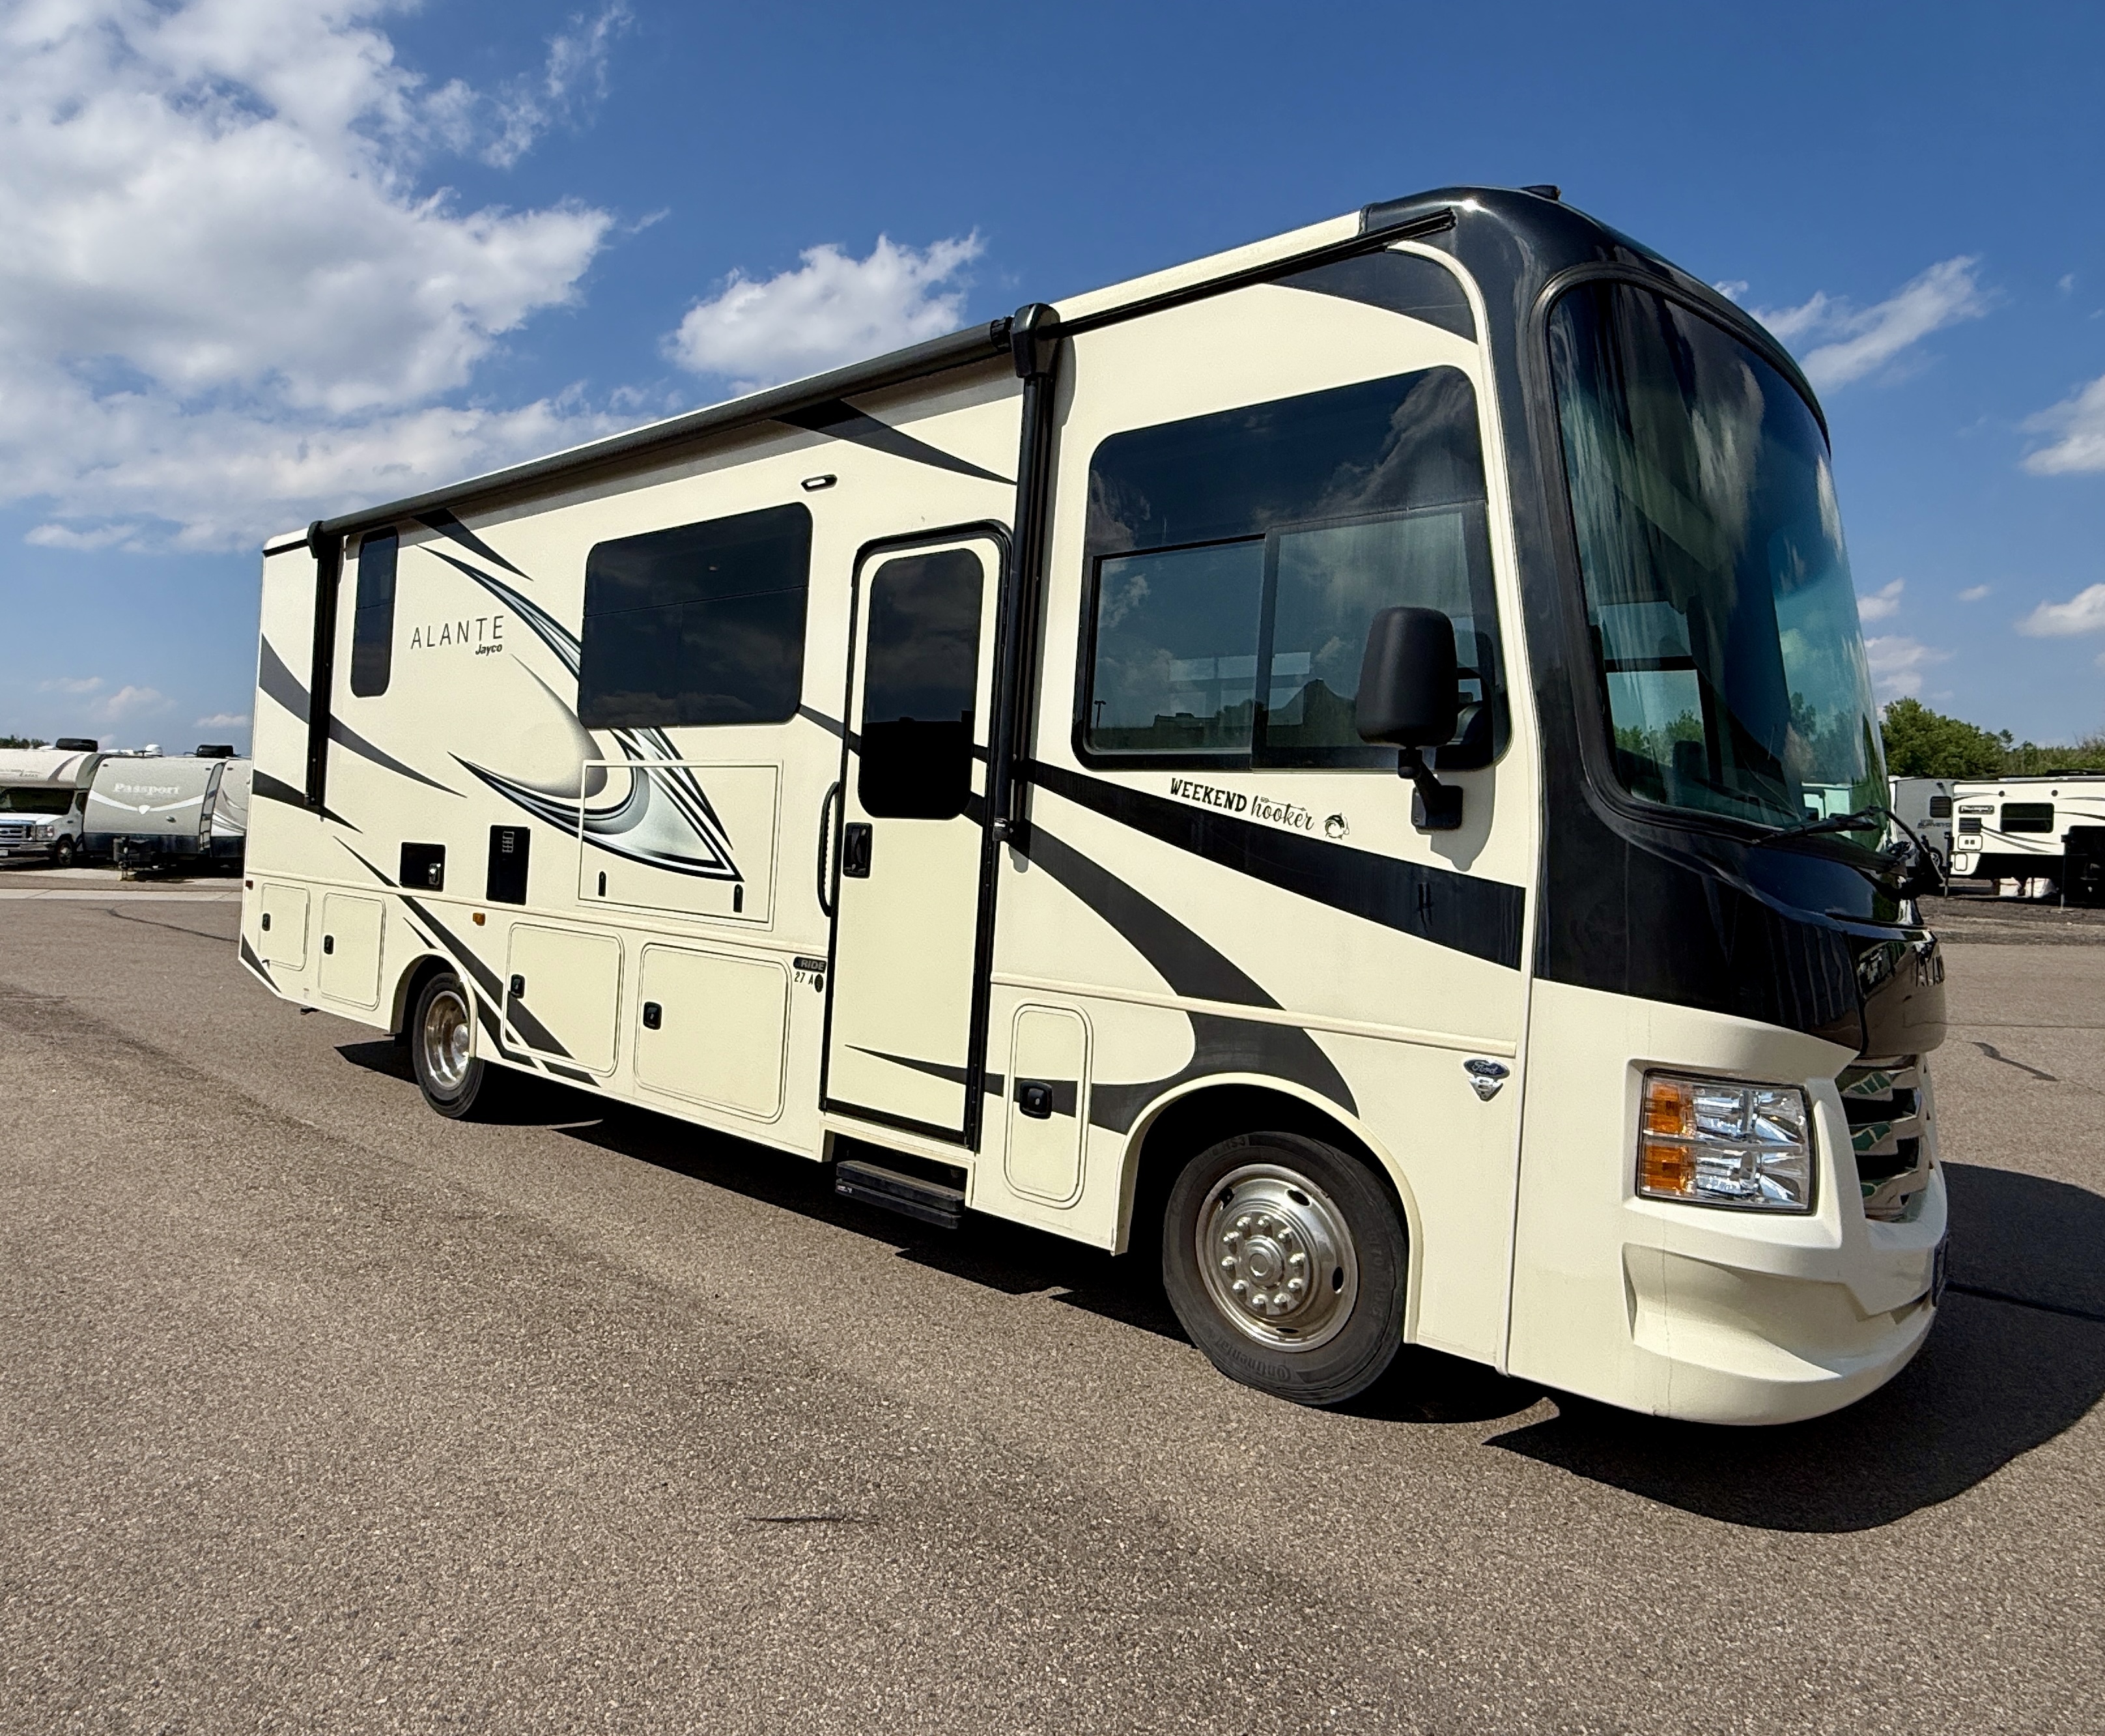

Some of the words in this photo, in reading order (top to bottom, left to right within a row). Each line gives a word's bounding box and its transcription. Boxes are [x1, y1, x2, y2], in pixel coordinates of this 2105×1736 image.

[410, 615, 504, 649] ALANTE
[475, 644, 503, 656] Jayco
[113, 783, 179, 796] Passport
[1170, 777, 1247, 812] WEEKEND
[1250, 795, 1314, 831] hooker
[794, 971, 806, 984] 27
[807, 973, 813, 985] A
[1471, 1060, 1498, 1075] Ford
